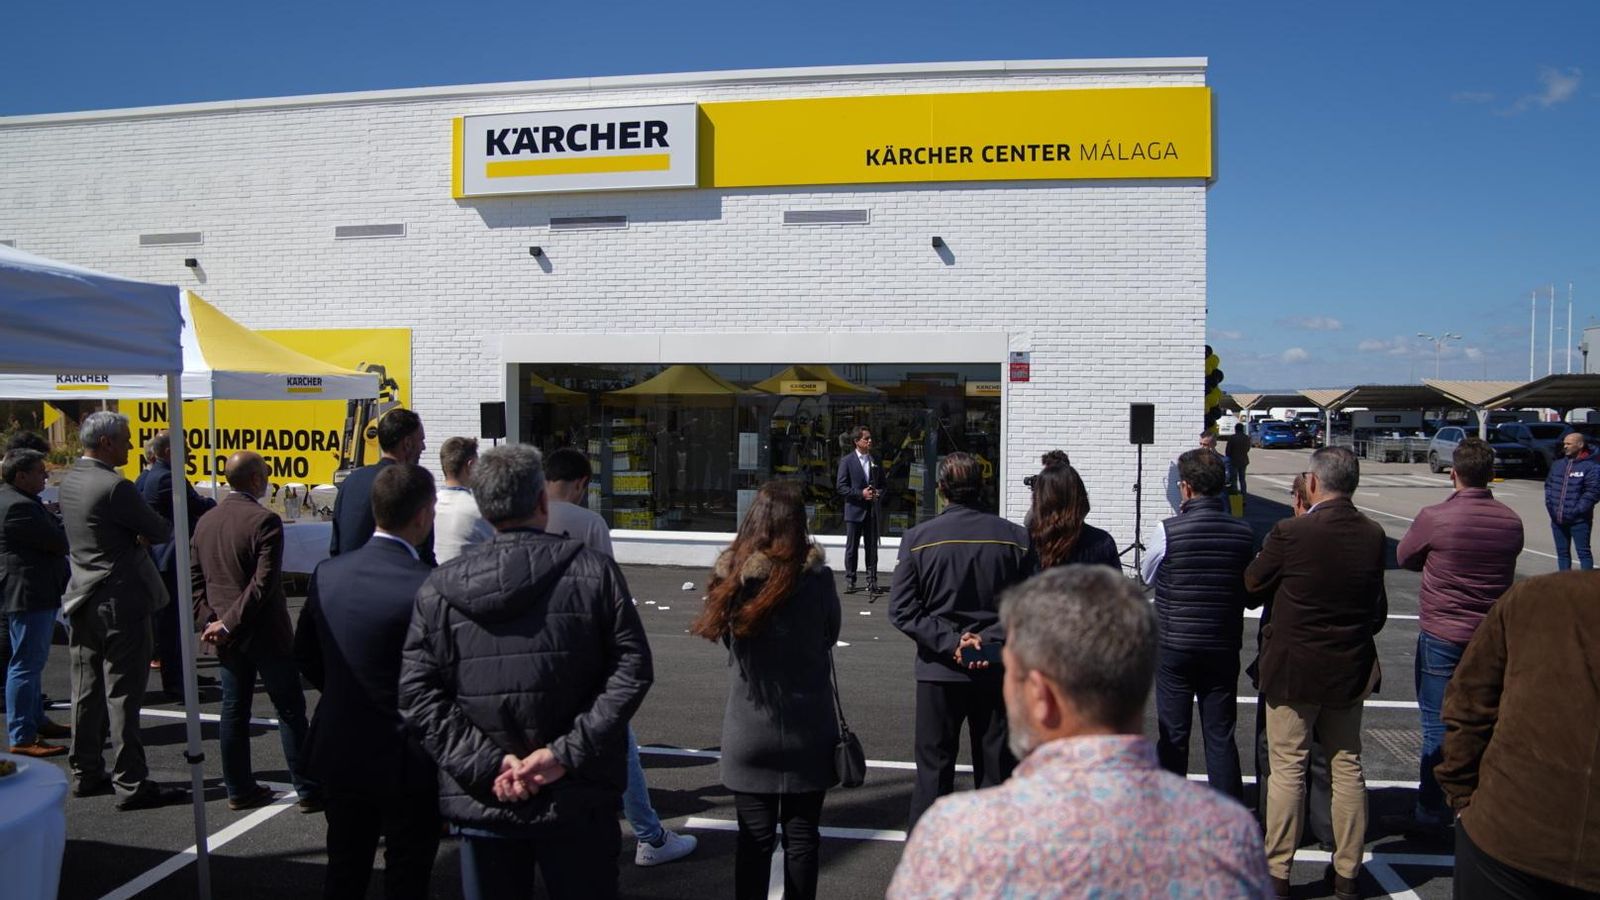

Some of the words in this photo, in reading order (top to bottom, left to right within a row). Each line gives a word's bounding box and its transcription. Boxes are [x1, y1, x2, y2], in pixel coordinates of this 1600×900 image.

[486, 120, 670, 156] KÄRCHER
[866, 145, 974, 166] KÄRCHER
[981, 143, 1071, 163] CENTER
[1080, 140, 1179, 161] MÁLAGA
[138, 402, 169, 422] UN
